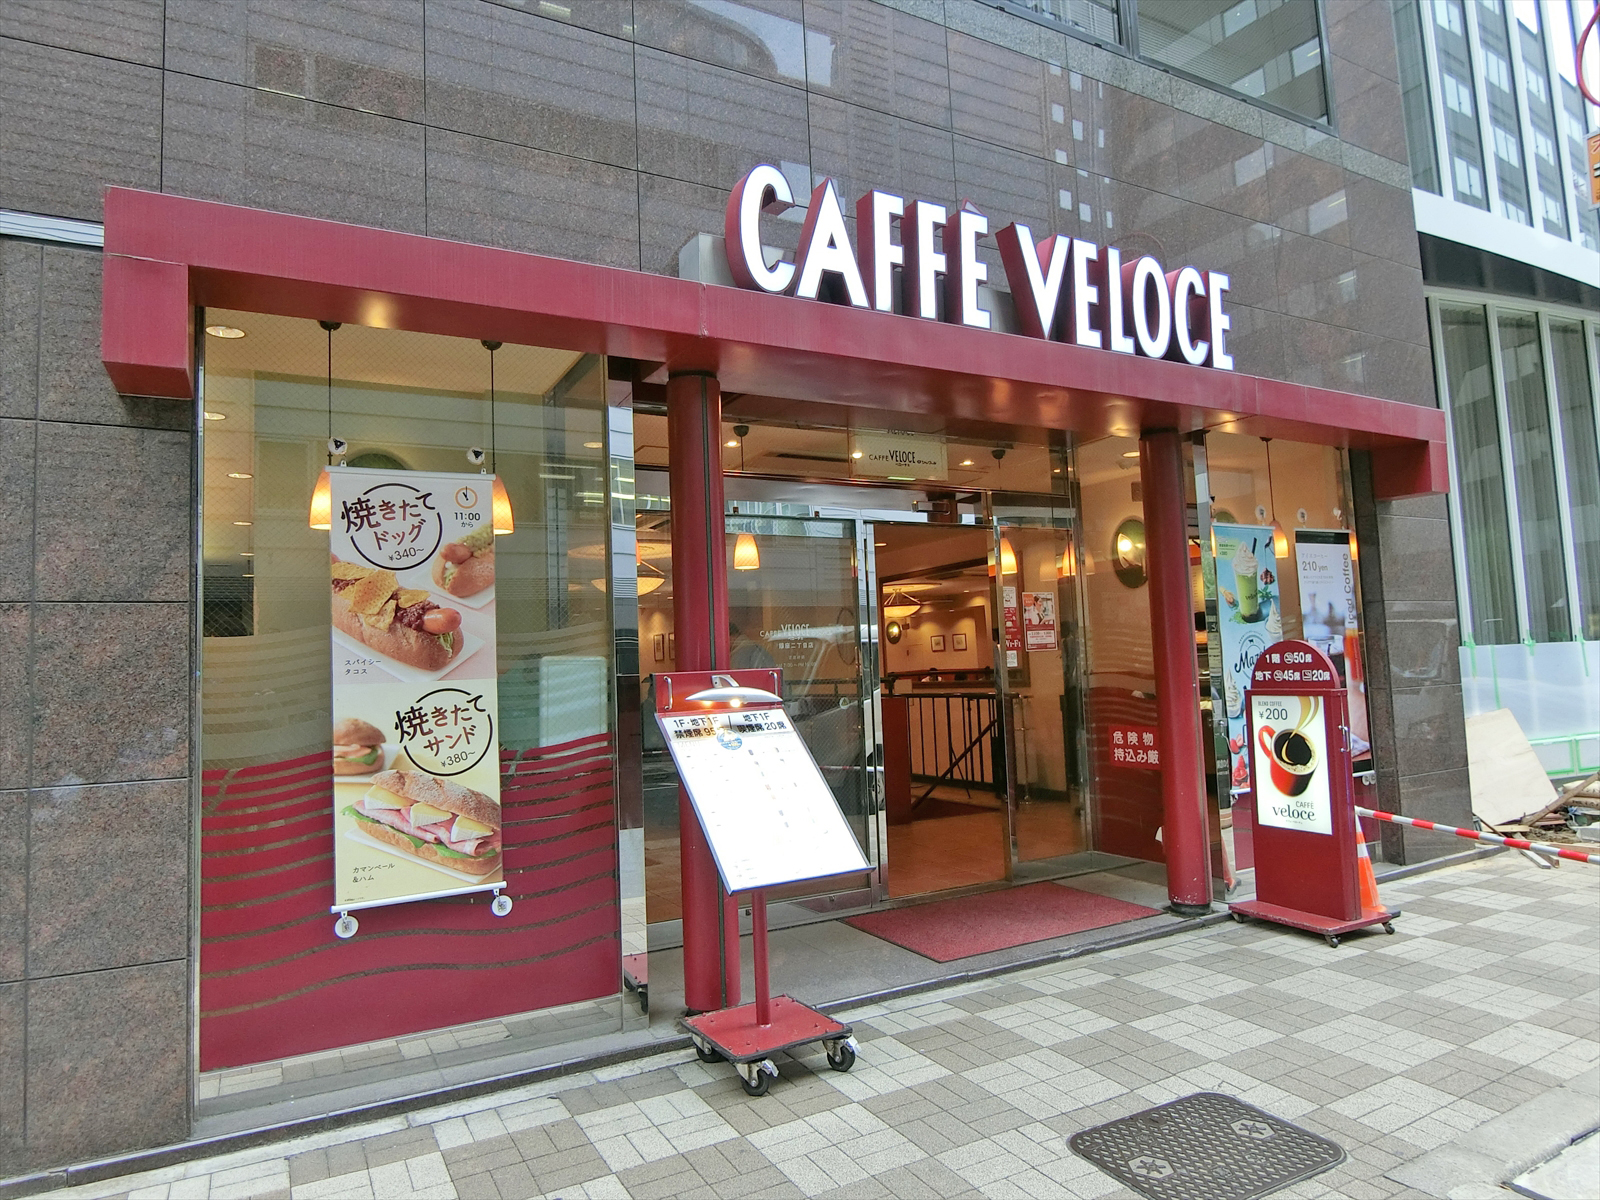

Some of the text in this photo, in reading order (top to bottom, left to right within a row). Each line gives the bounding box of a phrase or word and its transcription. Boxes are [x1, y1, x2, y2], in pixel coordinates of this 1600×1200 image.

[1005, 221, 1235, 371] VELOCE
[888, 449, 916, 464] VELOCE
[340, 492, 436, 534] 焼きたて
[454, 512, 481, 522] 11:00
[373, 518, 427, 551] ドッグ
[1301, 560, 1329, 572] 210 yen
[1341, 553, 1355, 624] Iced Coffee
[344, 658, 382, 666] スパイシー
[345, 668, 368, 676] タコス
[1254, 670, 1272, 681] 地下
[394, 694, 487, 744] 焼きたて
[1258, 707, 1289, 721] ¥200
[423, 724, 477, 757] サンド
[1112, 730, 1154, 746] 危険物
[1272, 803, 1317, 822] veloce
[352, 862, 396, 874] カマンベール
[352, 874, 375, 883] &ハム
